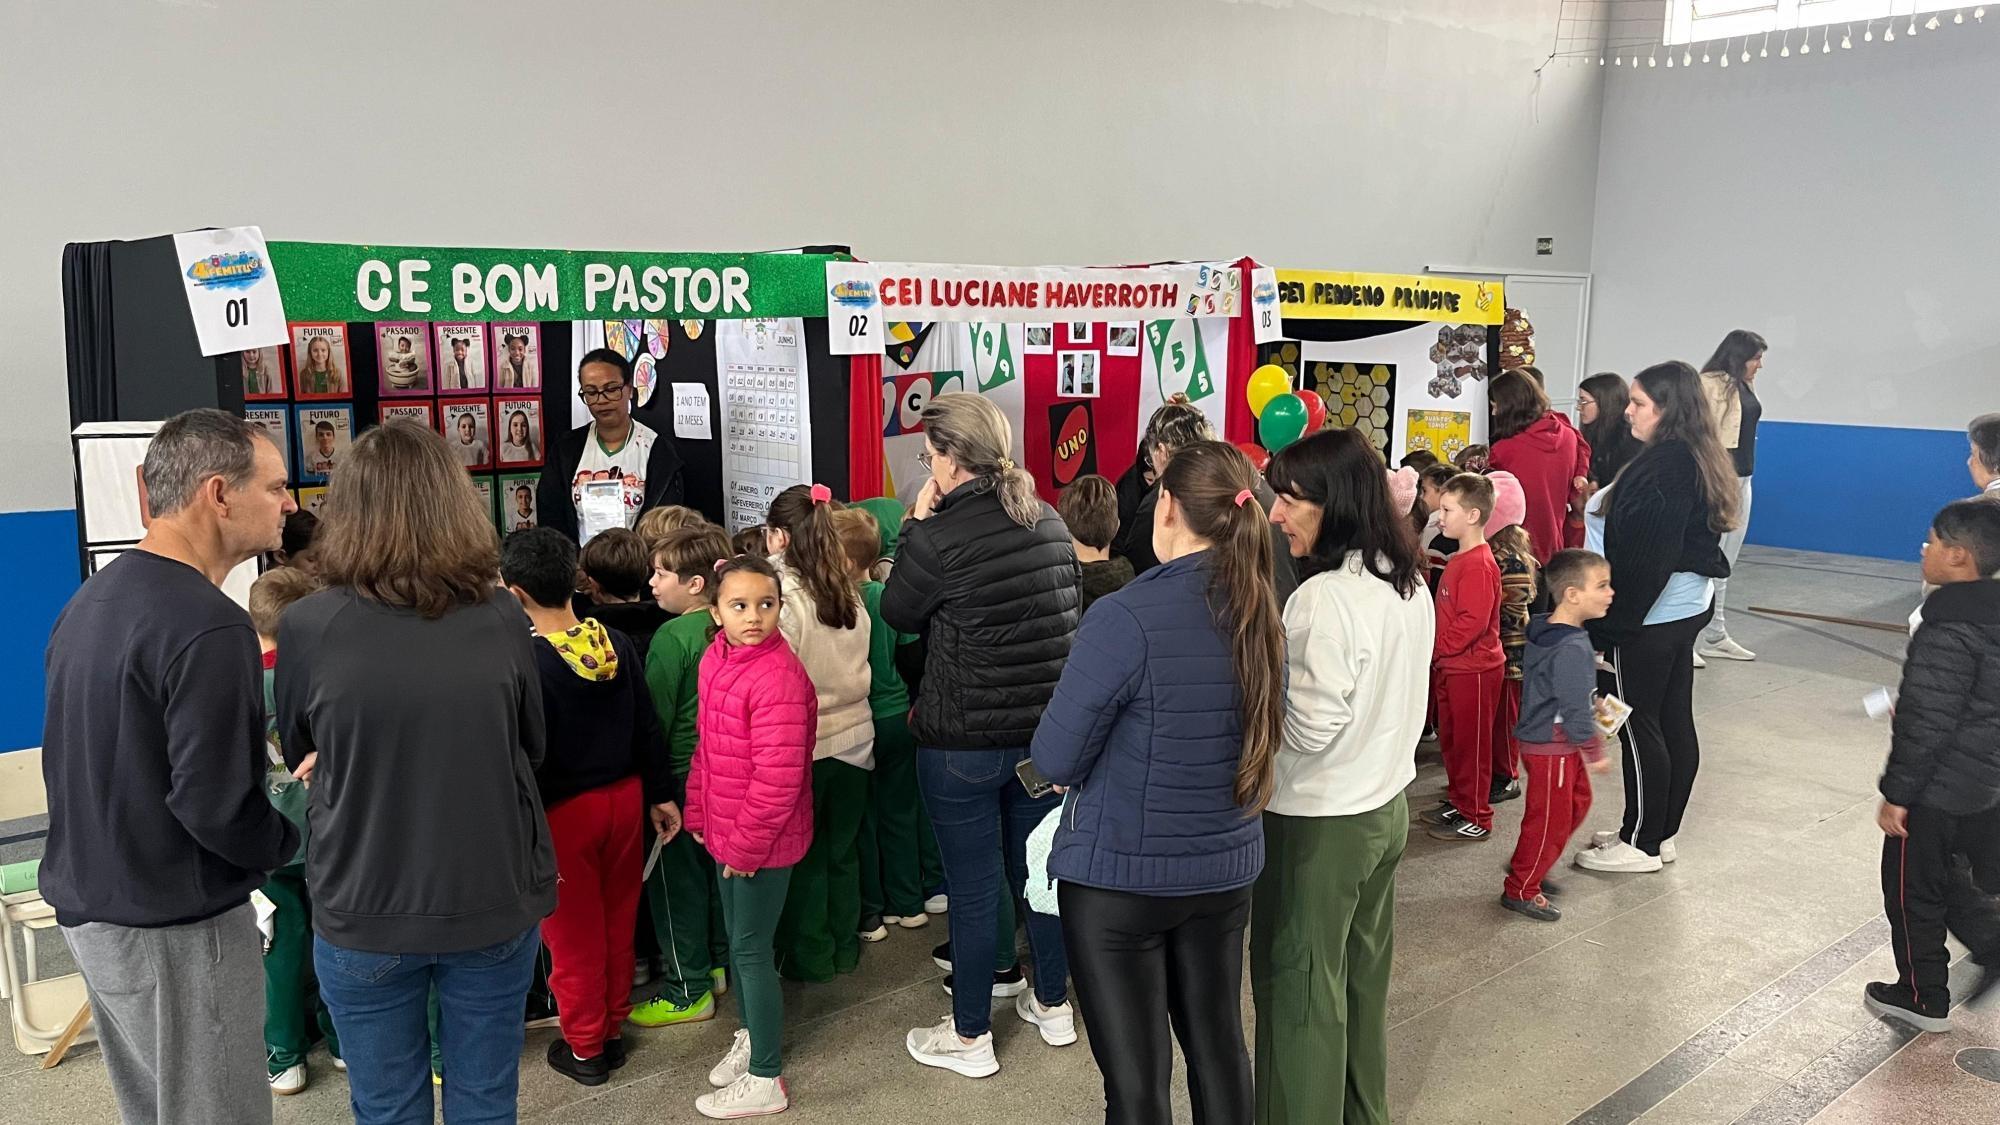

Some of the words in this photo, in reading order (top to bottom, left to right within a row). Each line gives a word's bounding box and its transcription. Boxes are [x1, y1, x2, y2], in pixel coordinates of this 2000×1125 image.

[357, 260, 432, 312] CE
[452, 263, 559, 314] BOM
[584, 263, 752, 314] PASTOR
[880, 278, 922, 306] CEI
[930, 278, 1039, 308] LUCIANE
[1045, 282, 1178, 309] HAVERROTH
[1278, 282, 1305, 303] CEI
[226, 298, 248, 327] 01
[1262, 310, 1272, 328] 03
[304, 328, 334, 336] FUTURO
[386, 327, 420, 335] PASSADO
[443, 326, 476, 334] PRESENTE
[502, 327, 530, 335] FUTURO
[849, 315, 868, 336] 02
[1150, 324, 1160, 346] 5
[984, 330, 993, 356] 9
[1172, 340, 1186, 373] 5
[1000, 358, 1010, 378] 9
[1198, 370, 1208, 392] 5
[505, 402, 532, 410] FUTURO
[681, 396, 692, 406] ANO
[694, 396, 706, 406] TEM
[908, 393, 921, 411] C
[245, 411, 280, 419] RESENTE
[310, 410, 340, 419] FUTURO
[390, 408, 422, 416] PASSADO
[450, 405, 481, 413] PRESENTE
[678, 415, 684, 424] 12
[685, 416, 704, 425] MESES
[1057, 428, 1088, 461] UNO
[731, 481, 737, 490] 01
[738, 485, 758, 495] JANEIRO
[765, 486, 774, 496] 07
[736, 500, 763, 510] FEVEREIRO
[732, 511, 738, 520] 03
[740, 514, 757, 524] MARÇO
